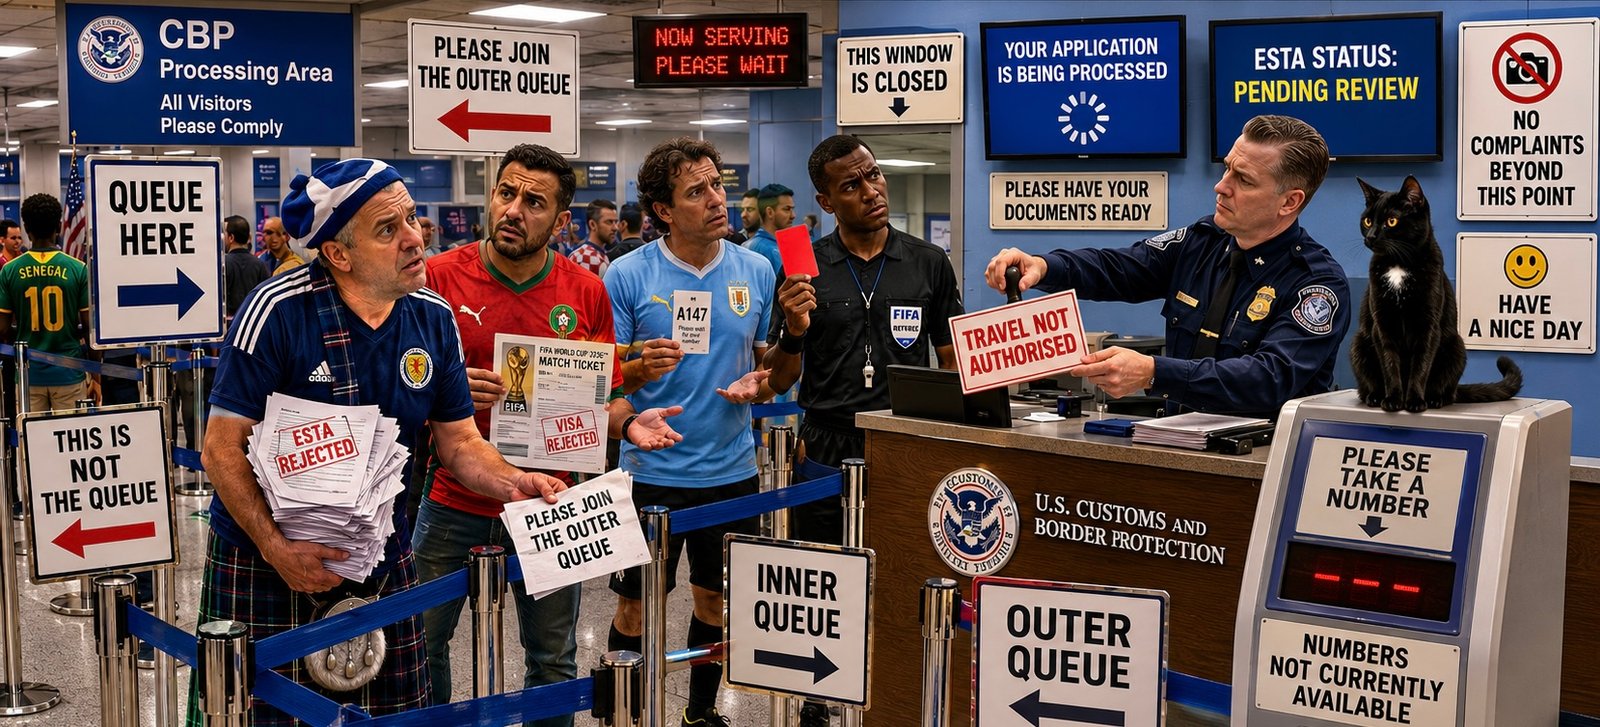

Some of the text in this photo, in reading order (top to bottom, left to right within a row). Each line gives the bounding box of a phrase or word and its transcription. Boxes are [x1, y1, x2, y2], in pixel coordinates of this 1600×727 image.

[159, 19, 234, 50] CBP
[656, 27, 789, 47] NOW SERVING
[434, 36, 550, 65] PLEASE JOIN
[847, 44, 952, 66] THIS WINDOW
[1005, 38, 1158, 59] YOUR APPLICATION
[1254, 44, 1398, 70] ESTA STATUS:
[160, 59, 279, 85] Processing
[286, 62, 332, 82] Area
[657, 55, 788, 75] PLEASE WAIT
[998, 62, 1167, 83] IS BEING PROCESSED
[418, 65, 571, 96] THE OUTER QUEUE
[852, 69, 948, 93] IS CLOSED
[1234, 77, 1419, 103] PENDING REVIEW
[160, 94, 252, 111] All Visitors
[161, 118, 283, 138] Please Comply
[1513, 110, 1539, 130] NO
[1471, 135, 1584, 156] COMPLAINTS
[1490, 161, 1563, 180] BEYOND
[109, 180, 203, 216] QUEUE
[1005, 180, 1148, 198] PLEASE HAVE YOUR
[1478, 186, 1575, 206] THIS POINT
[1005, 204, 1152, 221] DOCUMENTS READY
[120, 223, 195, 256] HERE
[19, 265, 68, 280] SENEGAL
[24, 286, 64, 332] 10
[676, 307, 708, 322] A147
[893, 309, 919, 321] FIFA
[1499, 295, 1551, 315] HAVE
[962, 308, 1069, 352] TRAVEL NOT
[1469, 319, 1583, 340] A NICE DAY
[538, 356, 606, 371] MATCH TICKET
[540, 346, 554, 354] FIFA
[554, 348, 575, 357] WORLD
[970, 332, 1078, 377] AUTHORISED
[292, 422, 334, 446] ESTA
[555, 416, 584, 432] VISA
[54, 424, 131, 453] THIS IS
[546, 431, 596, 452] REJECTED
[71, 455, 121, 483] NOT
[278, 438, 354, 475] REJECTED
[1342, 446, 1431, 473] PLEASE
[1341, 467, 1424, 495] TAKE A
[41, 481, 158, 515] THE QUEUE
[525, 489, 614, 530] PLEASE JOIN
[1326, 488, 1430, 518] NUMBER
[1034, 493, 1206, 538] U.S. CUSTOMS AND
[531, 510, 621, 553] THE OUTER
[1034, 518, 1224, 565] BORDER PROTECTION
[557, 538, 613, 570] QUEUE
[758, 563, 838, 602] INNER
[754, 600, 841, 639] QUEUE
[1006, 604, 1131, 648] OUTER
[1303, 633, 1409, 669] NUMBERS
[1008, 645, 1131, 689] QUEUE
[1270, 655, 1444, 702] NOT CURRENTLY
[1292, 685, 1411, 724] AVAILABLE
